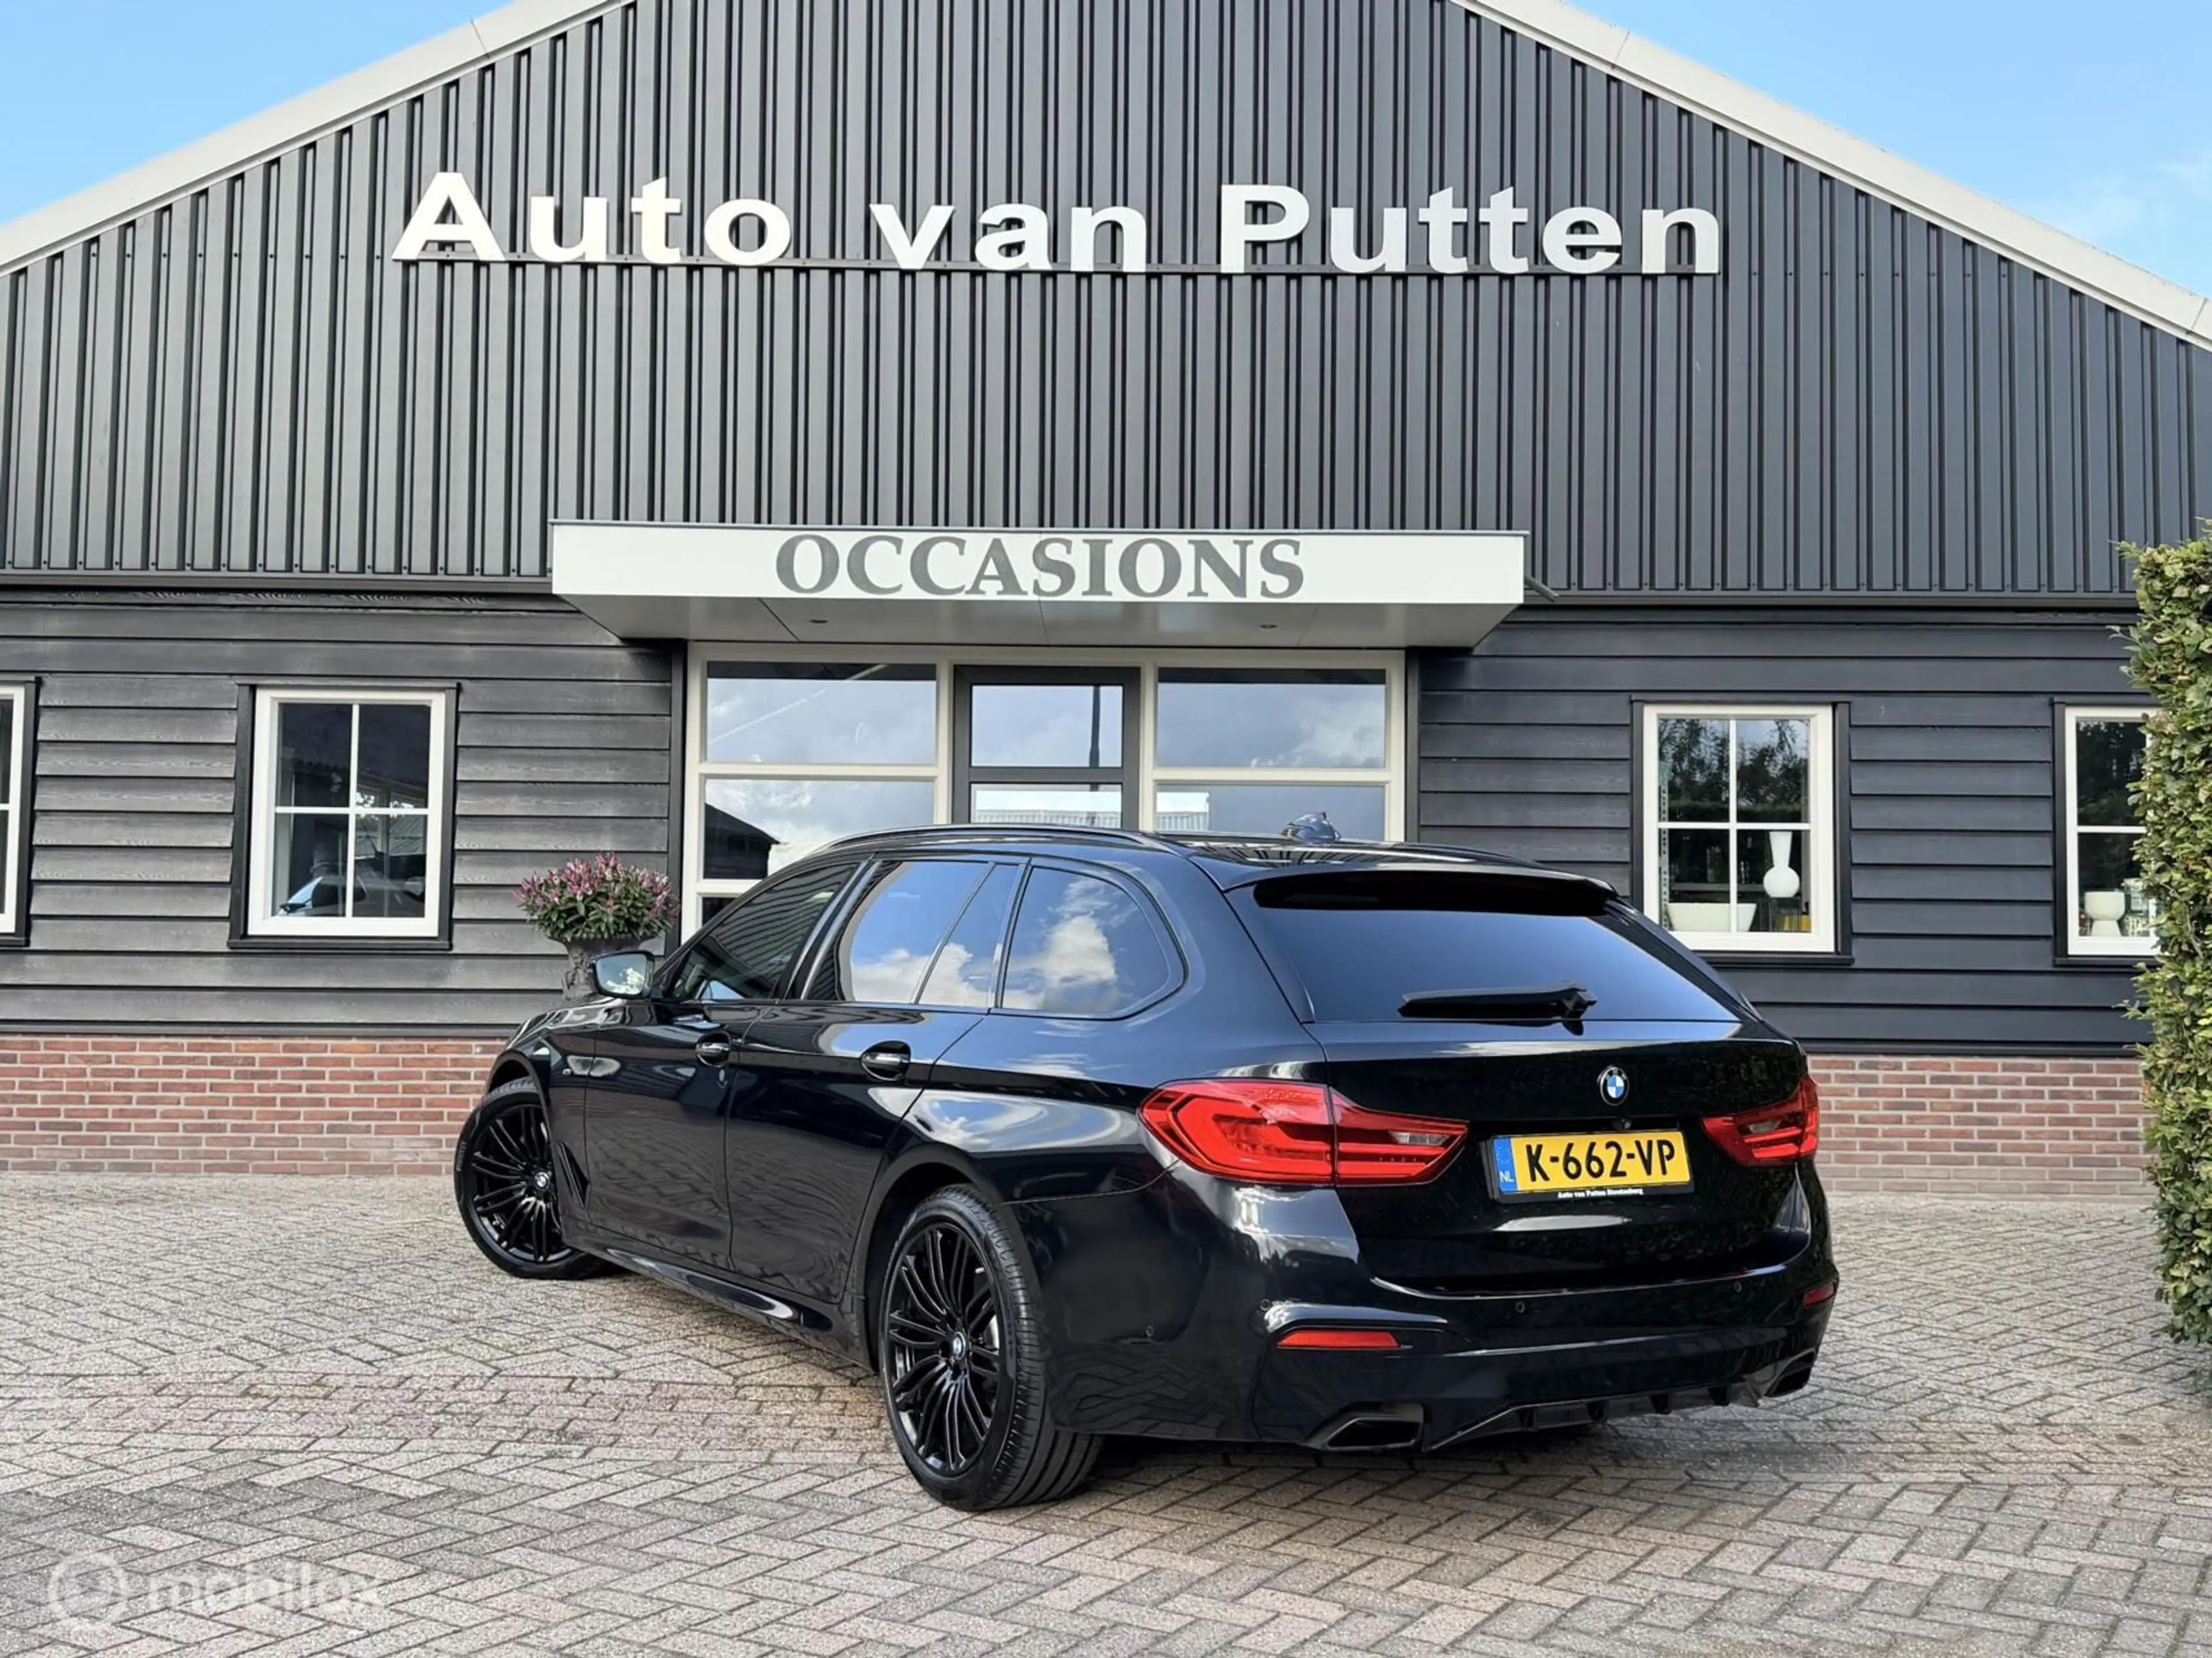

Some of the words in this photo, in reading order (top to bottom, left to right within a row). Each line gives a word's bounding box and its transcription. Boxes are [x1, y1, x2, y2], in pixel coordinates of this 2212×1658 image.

[391, 171, 790, 265] Auto
[869, 202, 1147, 273] van
[1221, 184, 1719, 274] Putten
[775, 534, 1304, 600] OCCASIONS
[1499, 1170, 1514, 1183] NL
[1525, 1139, 1675, 1182] K-662-VP
